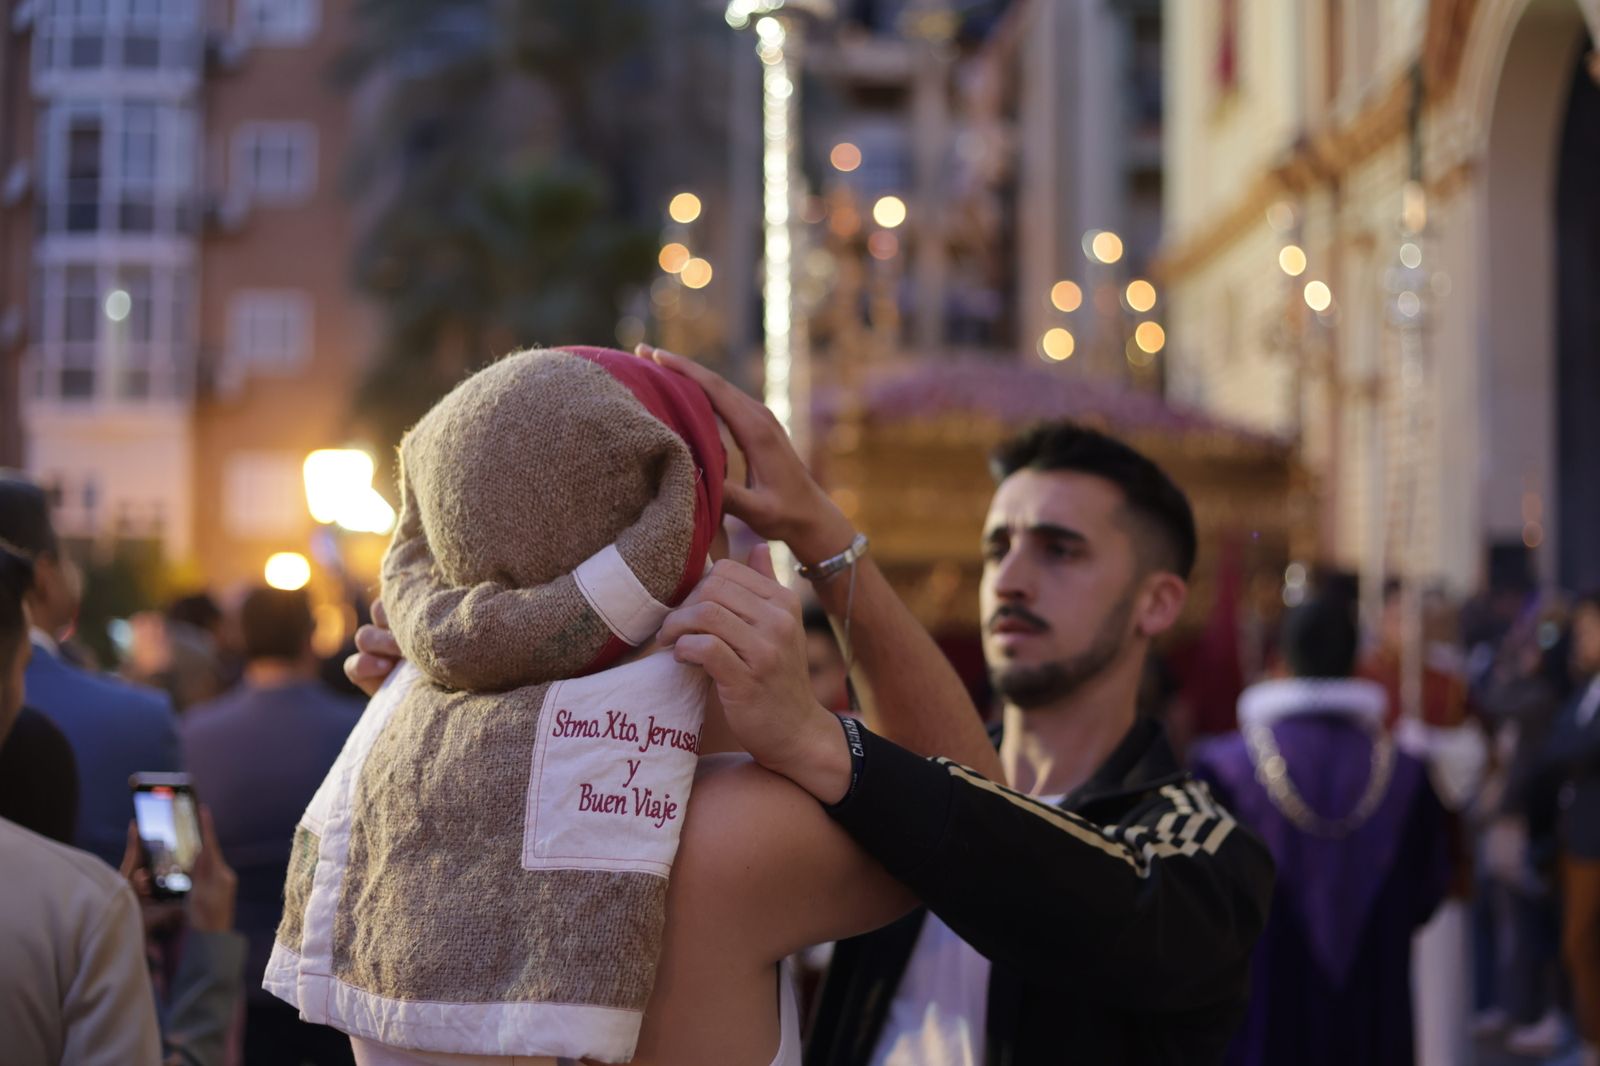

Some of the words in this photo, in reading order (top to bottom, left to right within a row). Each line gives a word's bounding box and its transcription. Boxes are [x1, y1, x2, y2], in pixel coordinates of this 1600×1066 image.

[622, 760, 640, 788] y
[578, 783, 627, 815] Buen
[632, 787, 678, 829] Viaje
